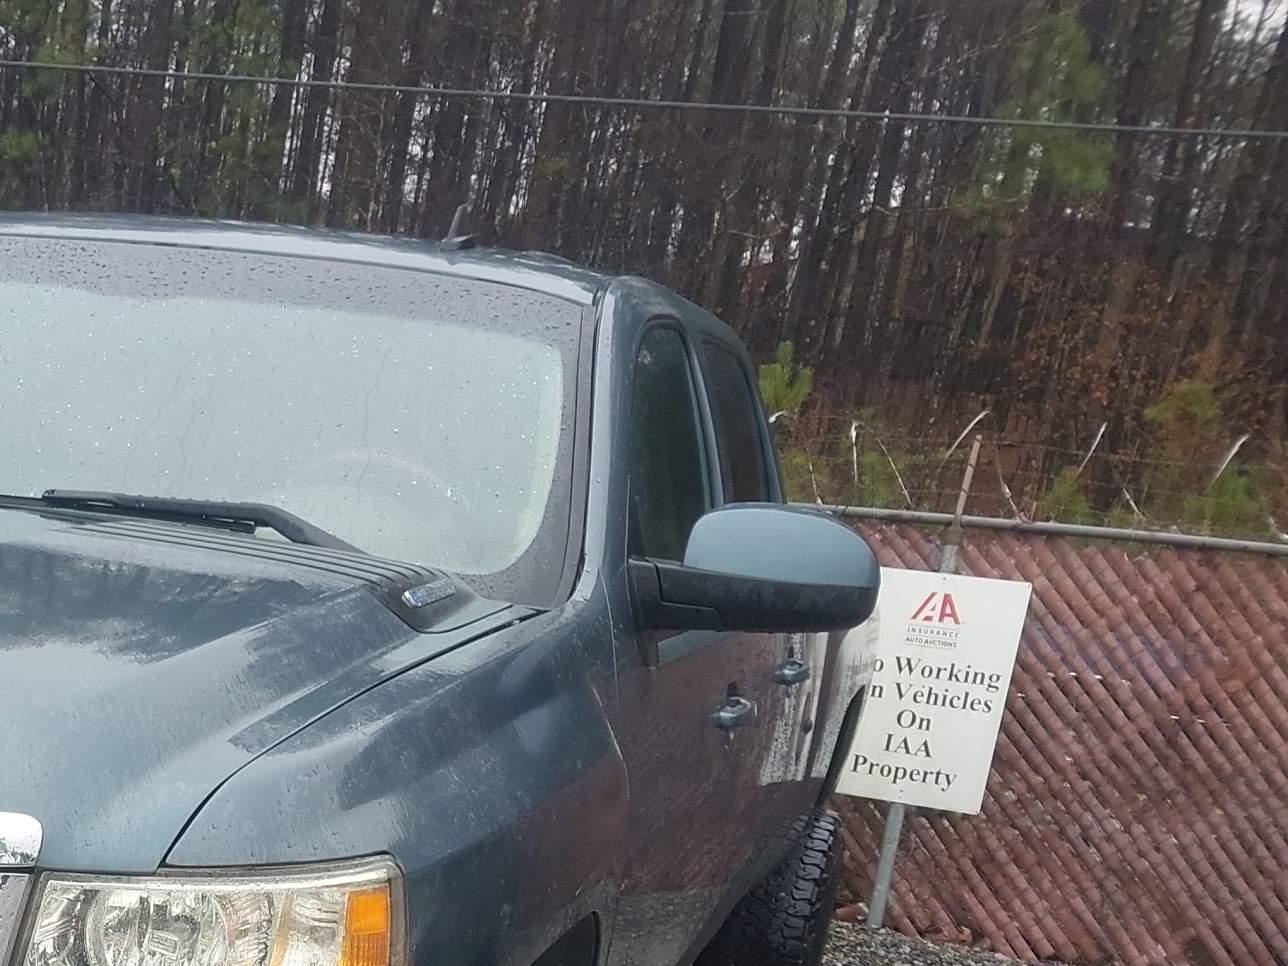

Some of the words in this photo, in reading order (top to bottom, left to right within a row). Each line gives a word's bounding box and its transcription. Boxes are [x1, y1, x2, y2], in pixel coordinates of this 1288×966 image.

[905, 636, 923, 644] AUTO
[924, 638, 958, 648] AUCTIONS
[907, 626, 959, 639] INSURANCE
[873, 658, 884, 672] o
[895, 656, 1003, 693] Working
[869, 684, 884, 699] n
[895, 682, 993, 713] Vehicles
[896, 709, 932, 732] On
[883, 733, 933, 758] IAA
[851, 754, 957, 792] Property
